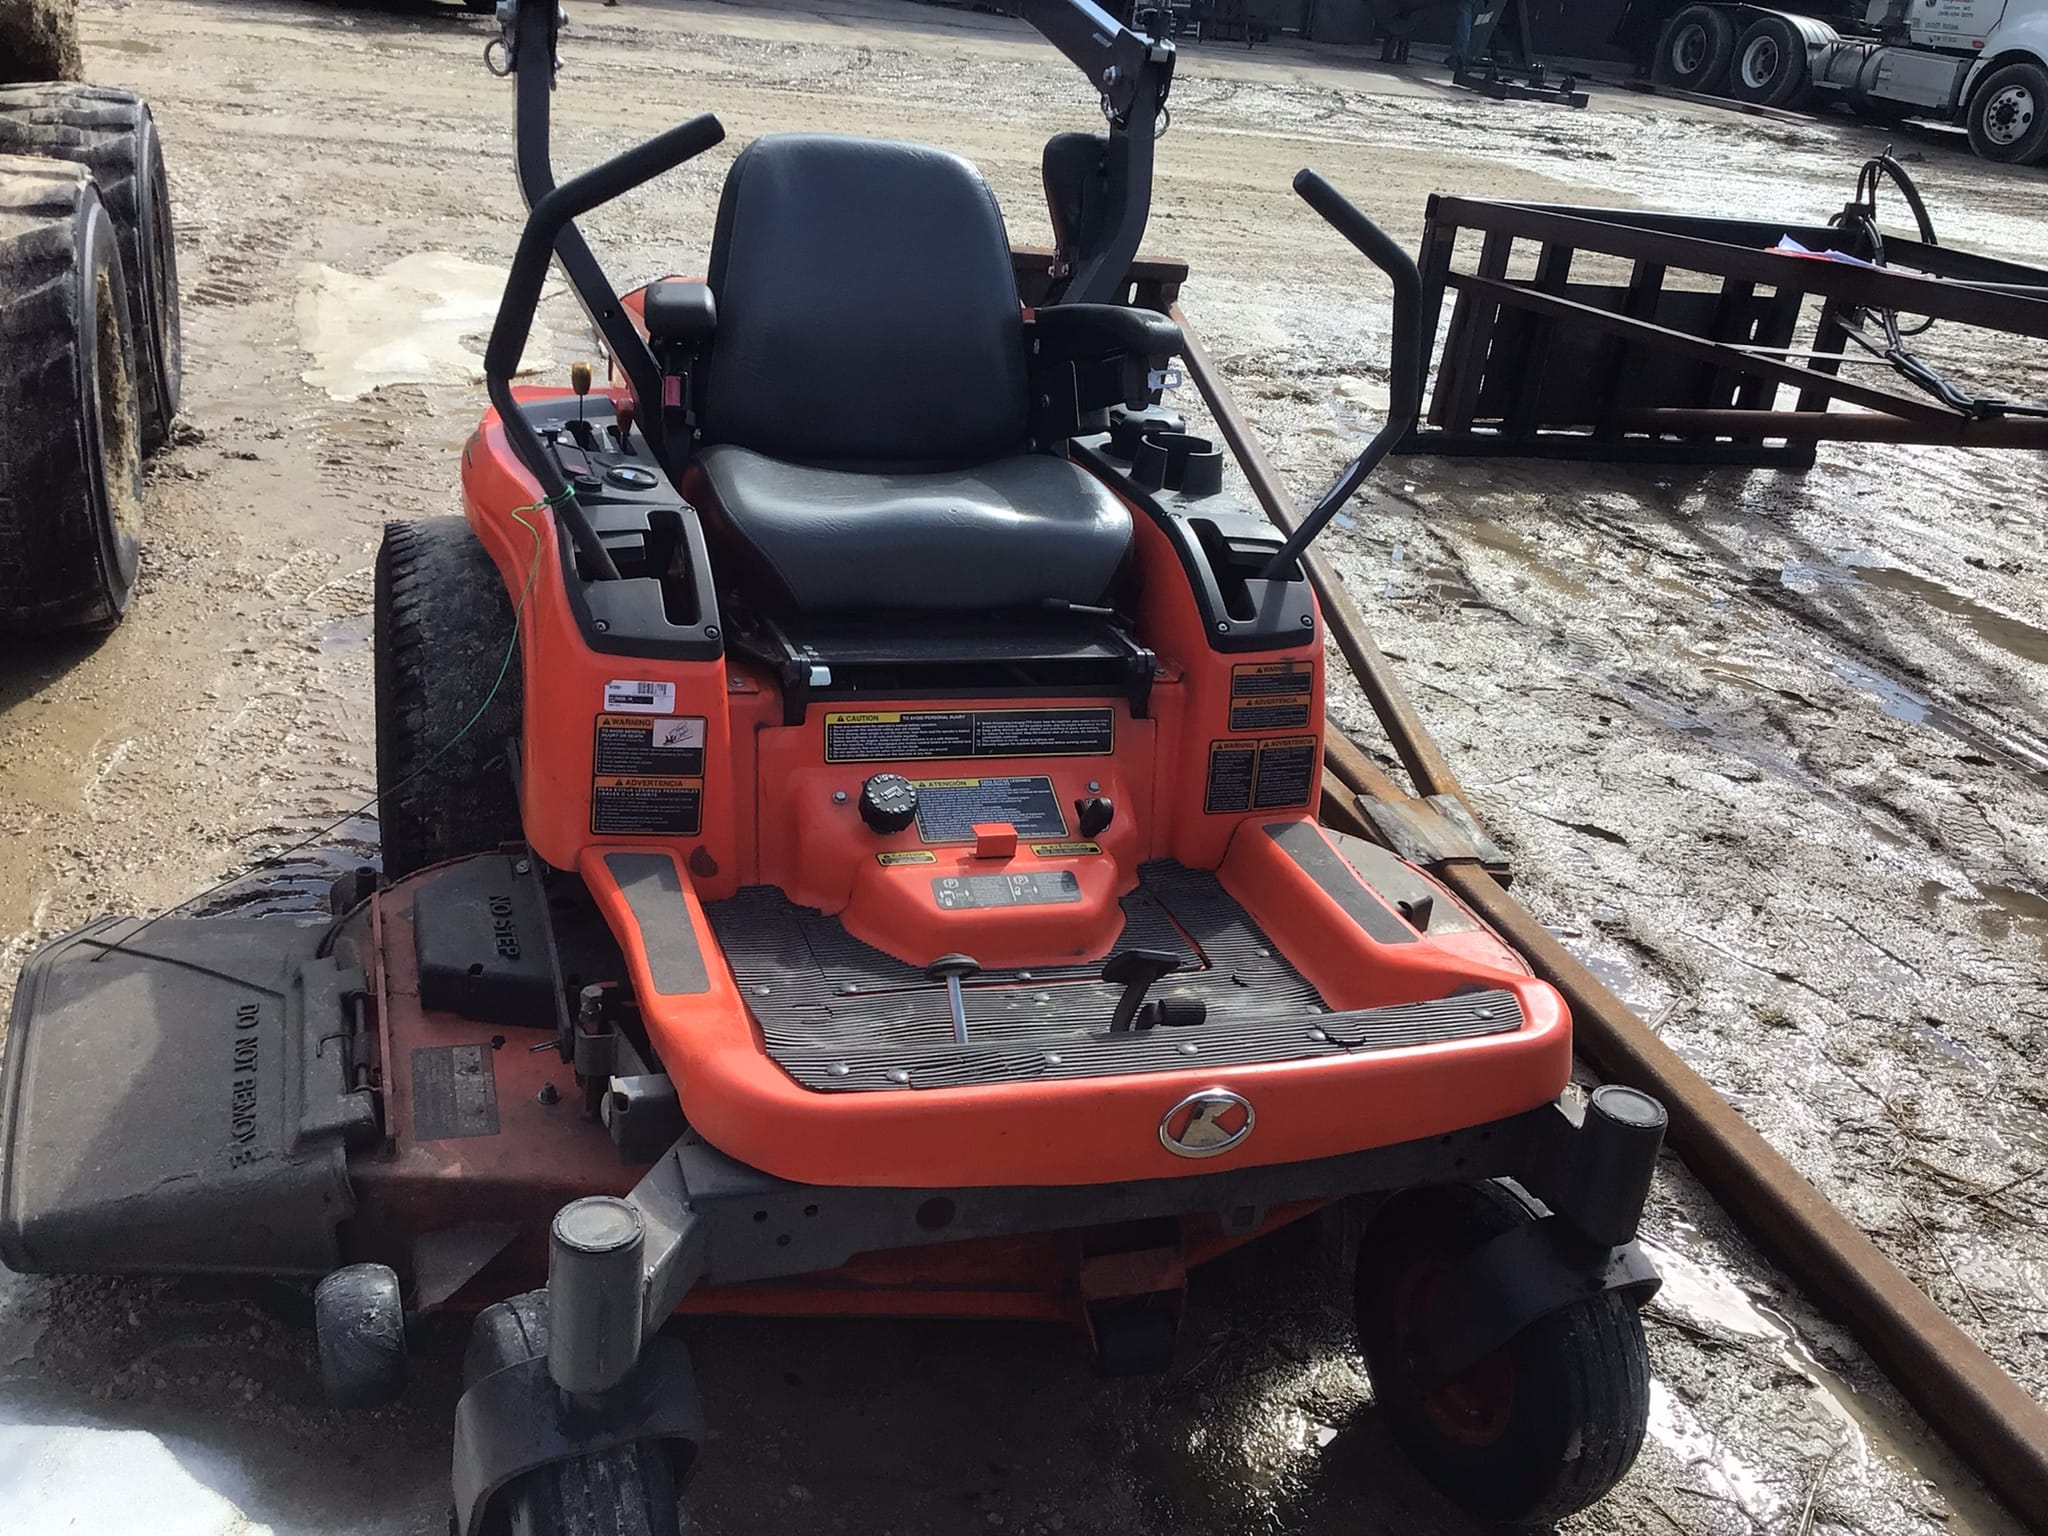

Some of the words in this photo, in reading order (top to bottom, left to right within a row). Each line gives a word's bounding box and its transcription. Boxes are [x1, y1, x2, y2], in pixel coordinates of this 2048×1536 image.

[1254, 697, 1298, 705] ADVERTENCIA
[612, 718, 651, 727] WARNING
[1270, 738, 1313, 747] ADVERTENCIA
[626, 779, 683, 787] ADVERTENCIA
[489, 896, 512, 917] NO
[493, 919, 520, 961] STEP
[235, 1003, 260, 1030] DO
[233, 1036, 259, 1072] NOT
[230, 1077, 258, 1170] REMOVE
